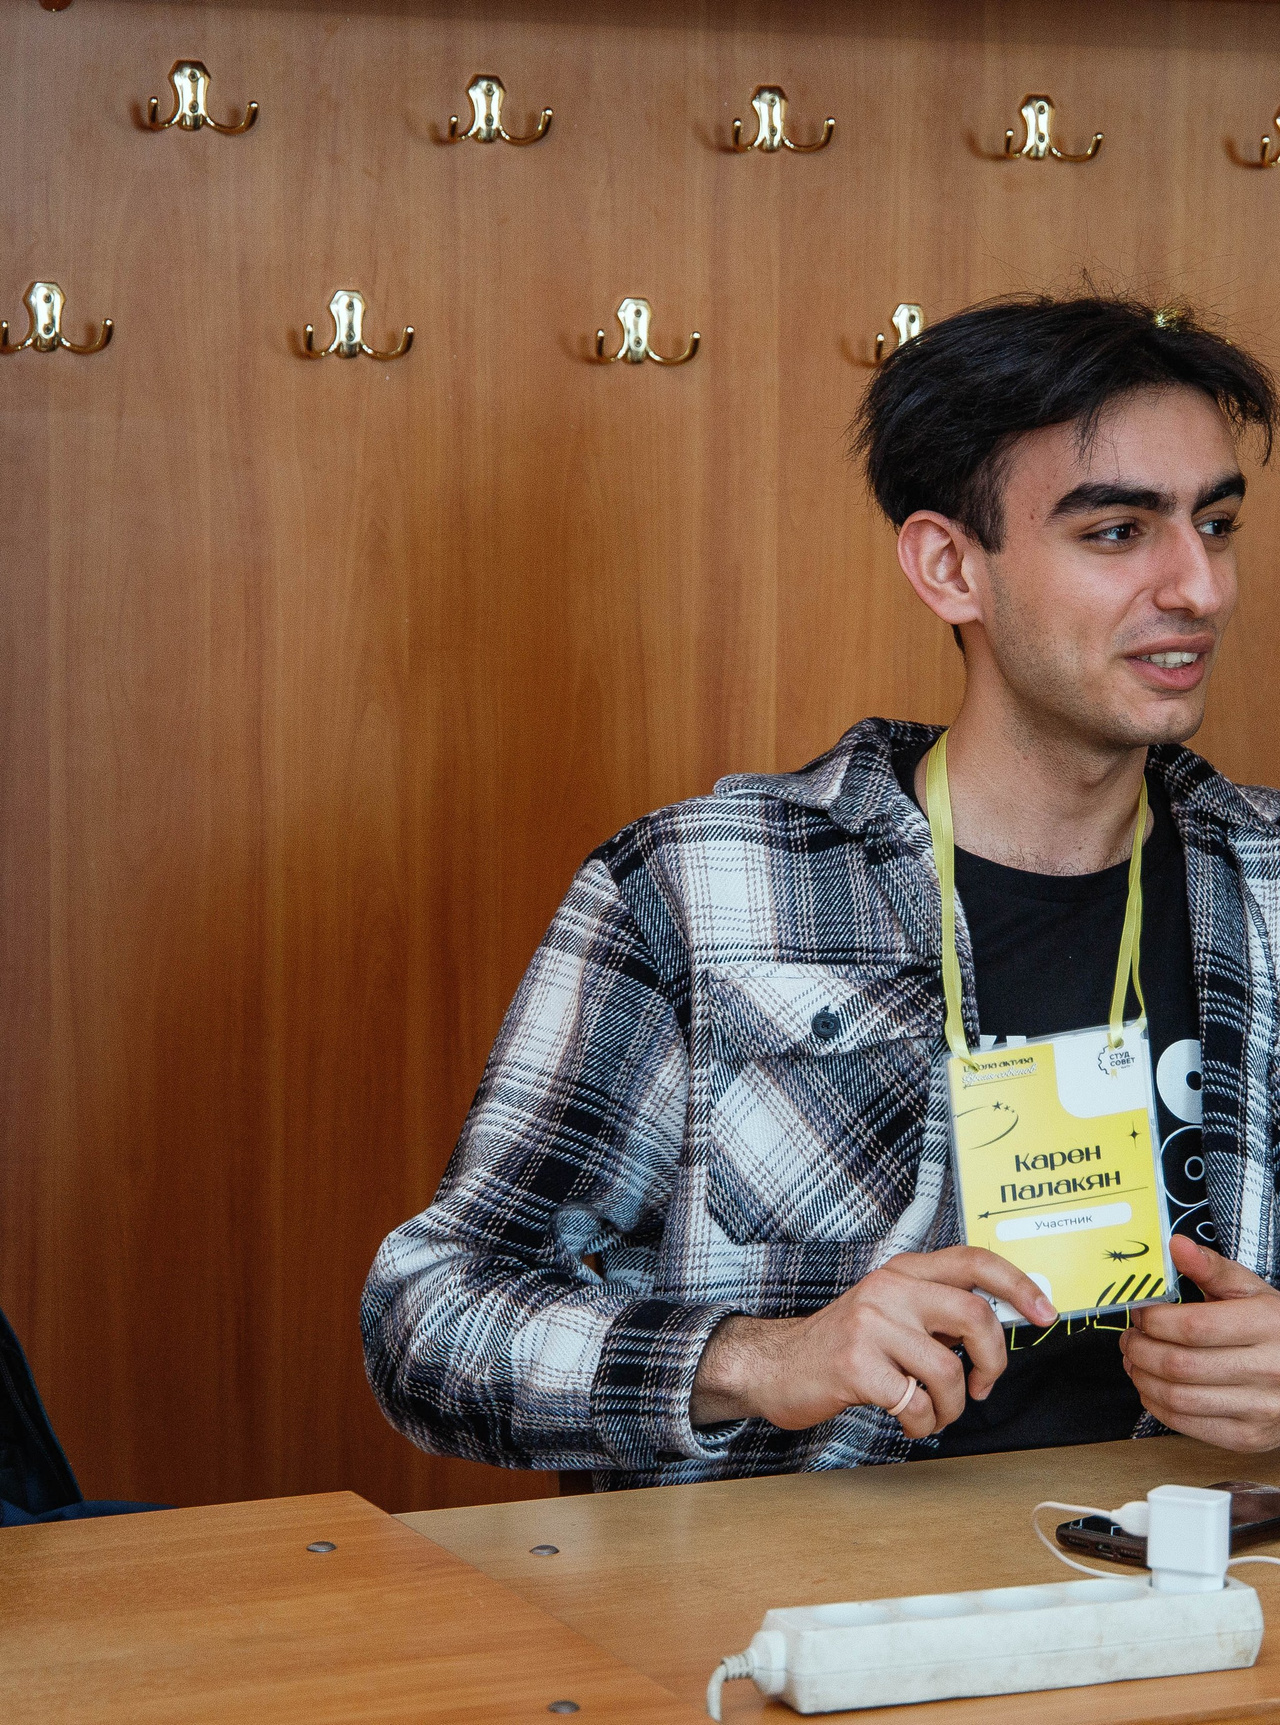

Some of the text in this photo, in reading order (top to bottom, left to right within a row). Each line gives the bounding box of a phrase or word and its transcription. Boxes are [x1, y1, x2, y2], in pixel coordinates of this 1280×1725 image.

[1109, 1051, 1130, 1060] СТУД
[1110, 1057, 1136, 1067] СОВЕТ
[963, 1061, 997, 1073] ола
[1015, 1145, 1102, 1173] Карен
[1000, 1170, 1122, 1203] Палакян
[1034, 1215, 1094, 1231] Участник
